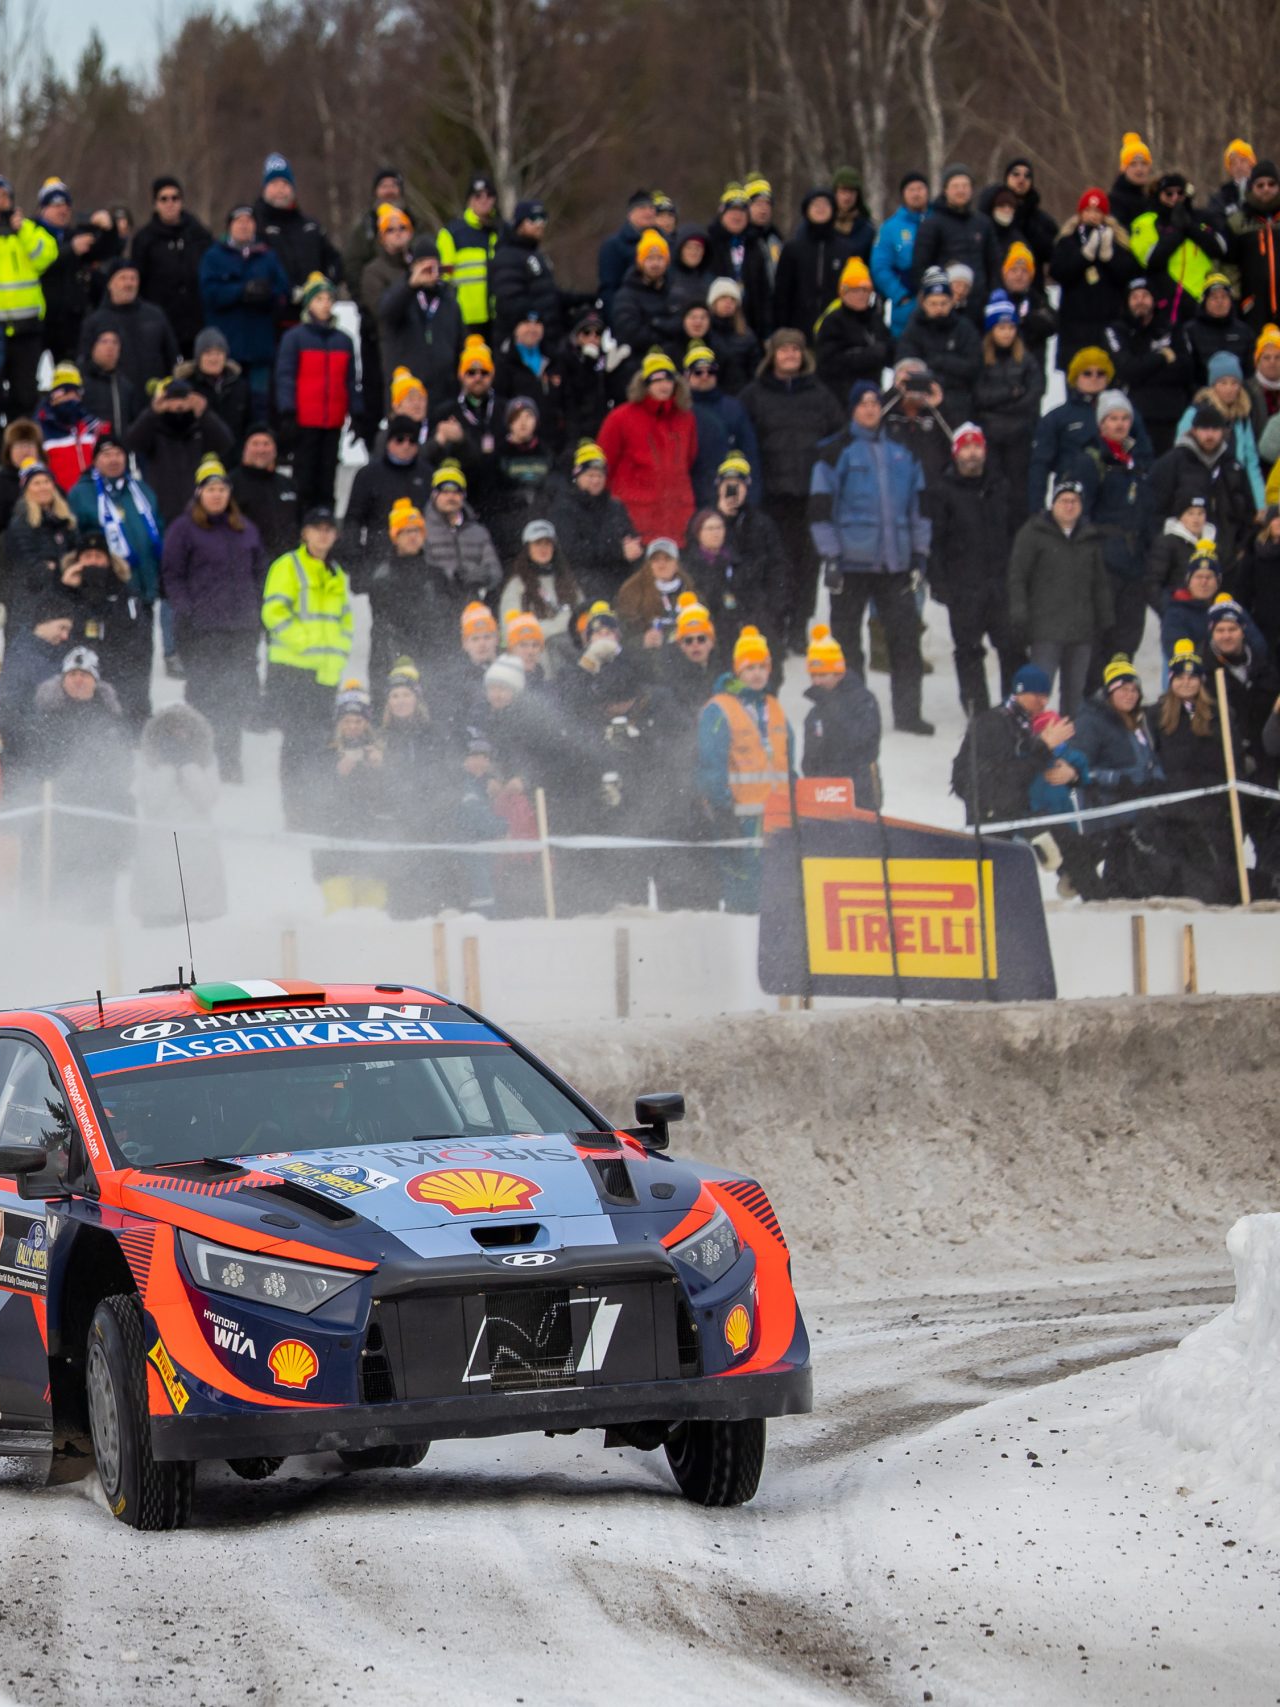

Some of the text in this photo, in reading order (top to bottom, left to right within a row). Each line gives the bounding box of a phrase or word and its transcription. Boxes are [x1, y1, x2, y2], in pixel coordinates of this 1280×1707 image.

[823, 881, 977, 955] PIRELLI
[193, 1006, 350, 1030] HYUNDAI
[63, 1064, 100, 1160] motorsport.hyundai.com
[322, 1142, 477, 1162] HYUNDAI
[384, 1148, 577, 1168] MOBIS
[279, 1161, 325, 1177] RALLY
[313, 1173, 370, 1194] SWEDEN
[292, 1176, 320, 1188] 2023
[203, 1309, 239, 1331] HYUNDAI
[214, 1325, 257, 1360] WIA
